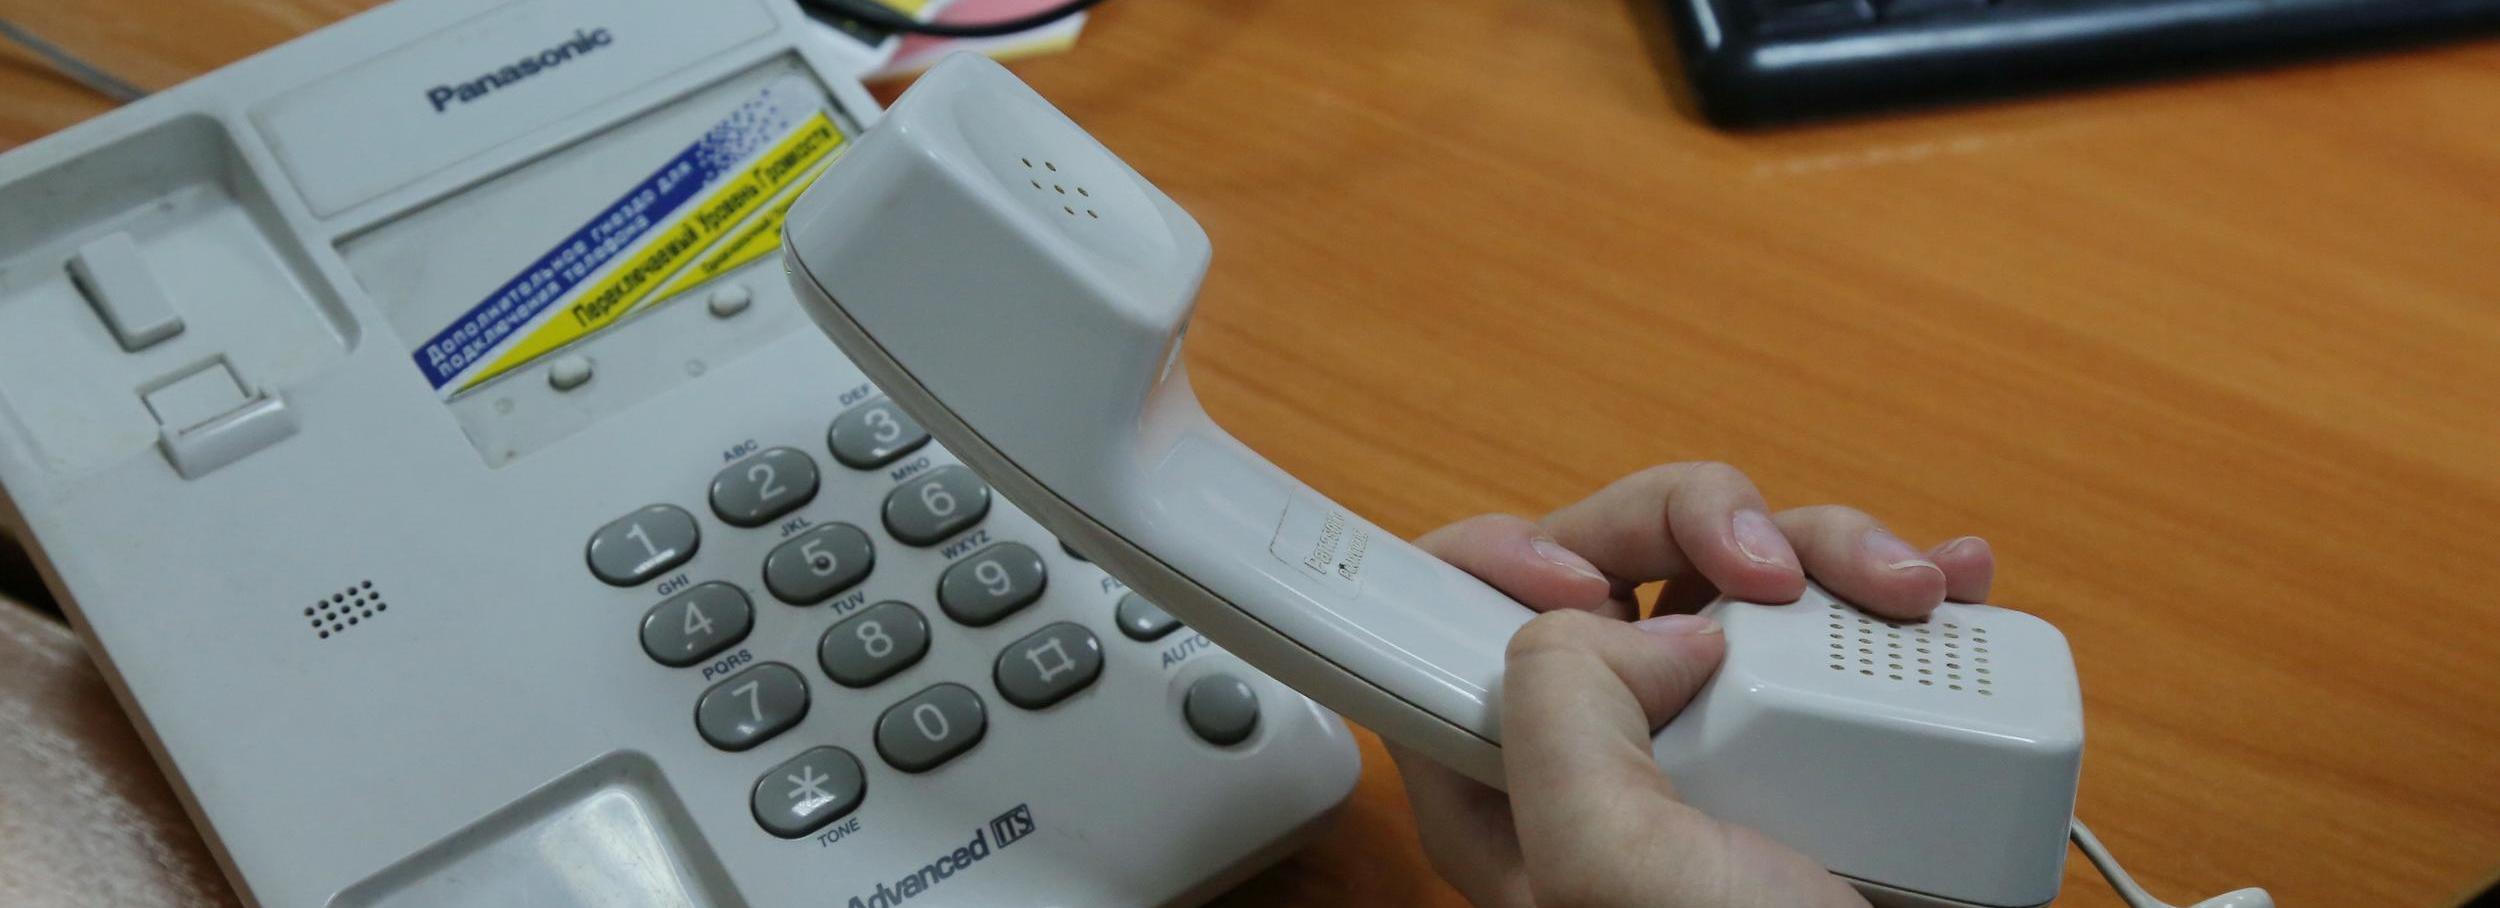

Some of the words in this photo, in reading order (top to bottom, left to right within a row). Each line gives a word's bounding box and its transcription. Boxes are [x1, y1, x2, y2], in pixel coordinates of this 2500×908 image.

[427, 27, 612, 112] Panasonic
[840, 383, 869, 405] DEF
[864, 408, 900, 442] 3
[723, 438, 759, 462] ABC
[747, 463, 787, 500] 2
[891, 457, 930, 481] MNO
[921, 482, 956, 517] 6
[626, 523, 658, 557] 1
[780, 517, 811, 538] JKL
[941, 529, 991, 560] WXYZ
[800, 537, 837, 576] 5
[656, 573, 689, 597] GHI
[975, 560, 1011, 596] 9
[684, 600, 713, 635] 4
[830, 592, 865, 615] TUV
[856, 620, 894, 658] 8
[1161, 634, 1210, 669] AUTO
[702, 650, 753, 681] PQRS
[732, 680, 764, 722] 7
[912, 703, 949, 742] 0
[816, 817, 861, 848] TONE
[848, 828, 991, 908] Advanced
[992, 804, 1035, 848] ITS
